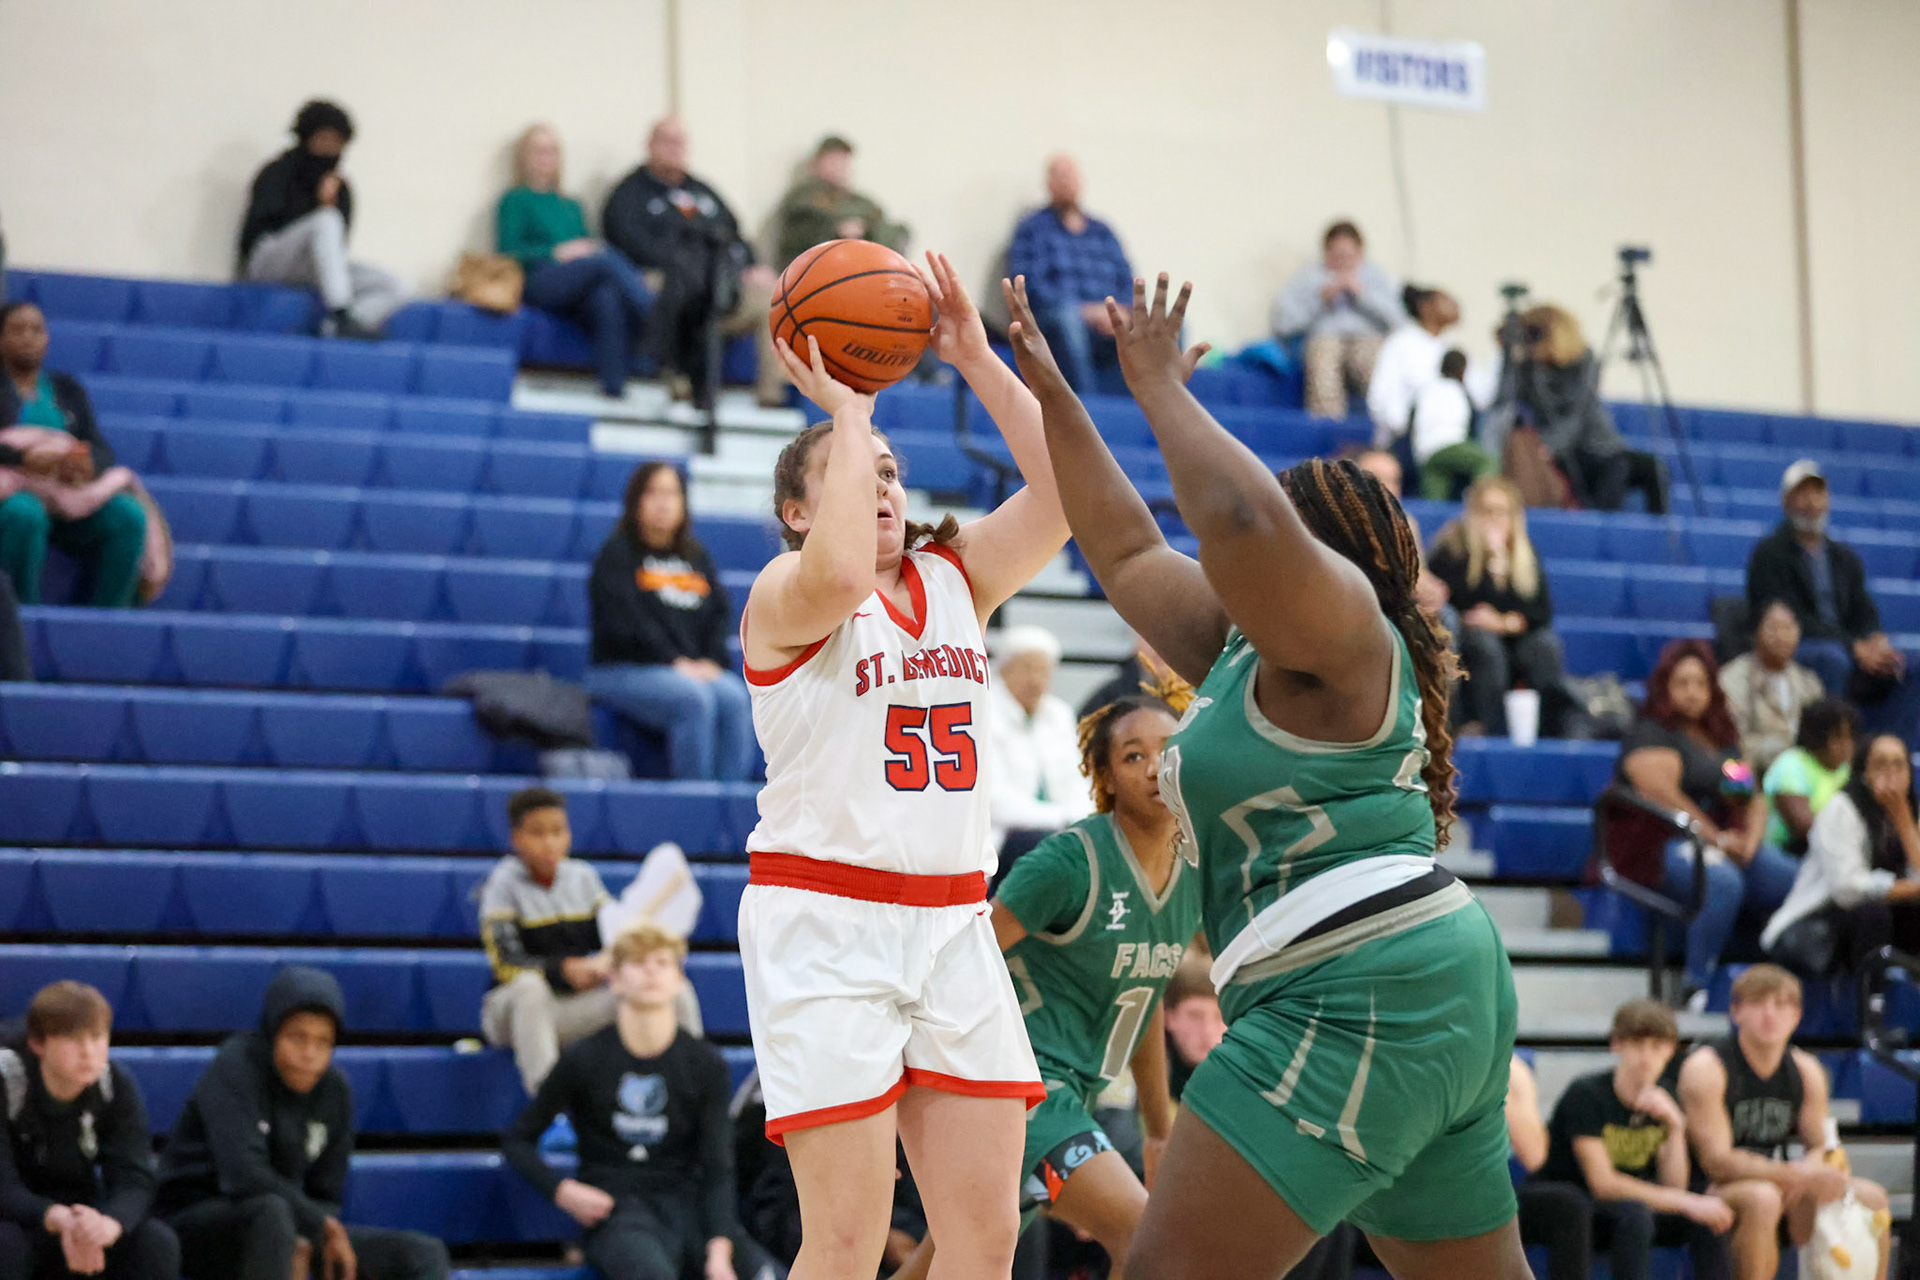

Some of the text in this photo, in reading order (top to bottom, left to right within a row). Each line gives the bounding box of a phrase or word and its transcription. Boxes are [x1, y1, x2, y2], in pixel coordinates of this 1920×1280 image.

[1355, 49, 1467, 93] VISITORS
[856, 651, 895, 697] ST.
[884, 701, 978, 792] 55
[1099, 986, 1155, 1082] 1
